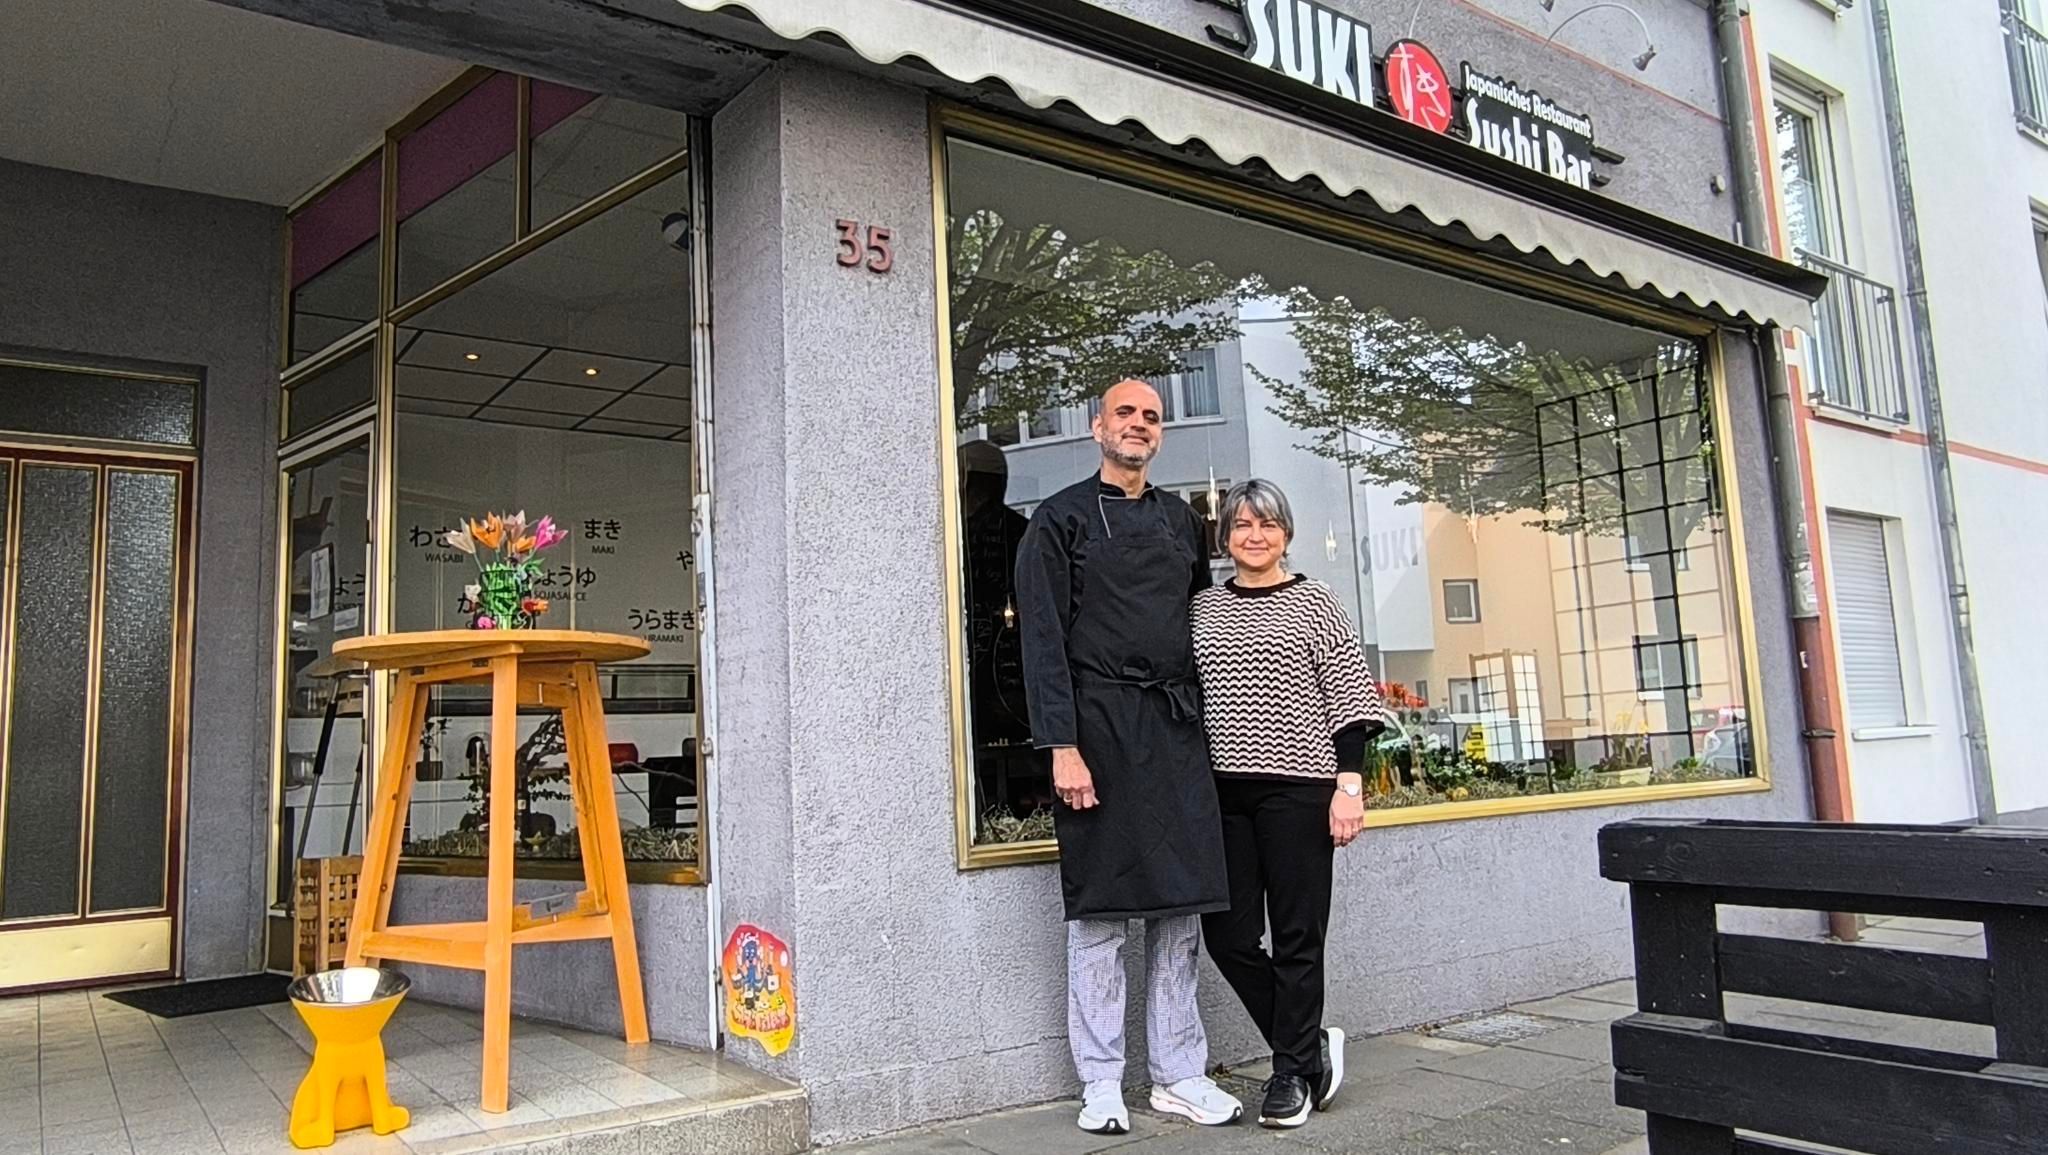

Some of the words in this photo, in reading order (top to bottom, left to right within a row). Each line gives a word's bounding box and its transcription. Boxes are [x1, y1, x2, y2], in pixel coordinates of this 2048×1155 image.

[1247, 0, 1374, 108] SUKI
[1464, 64, 1531, 114] Japanisches
[1532, 94, 1592, 138] Restaurant
[1466, 97, 1542, 173] Sushi
[1546, 129, 1592, 191] Bar
[836, 219, 892, 273] 35
[583, 518, 622, 540] まき
[591, 545, 615, 555] MAKI
[1360, 527, 1418, 576] SUKI
[424, 552, 464, 563] WASABI
[628, 608, 695, 631] うらまき
